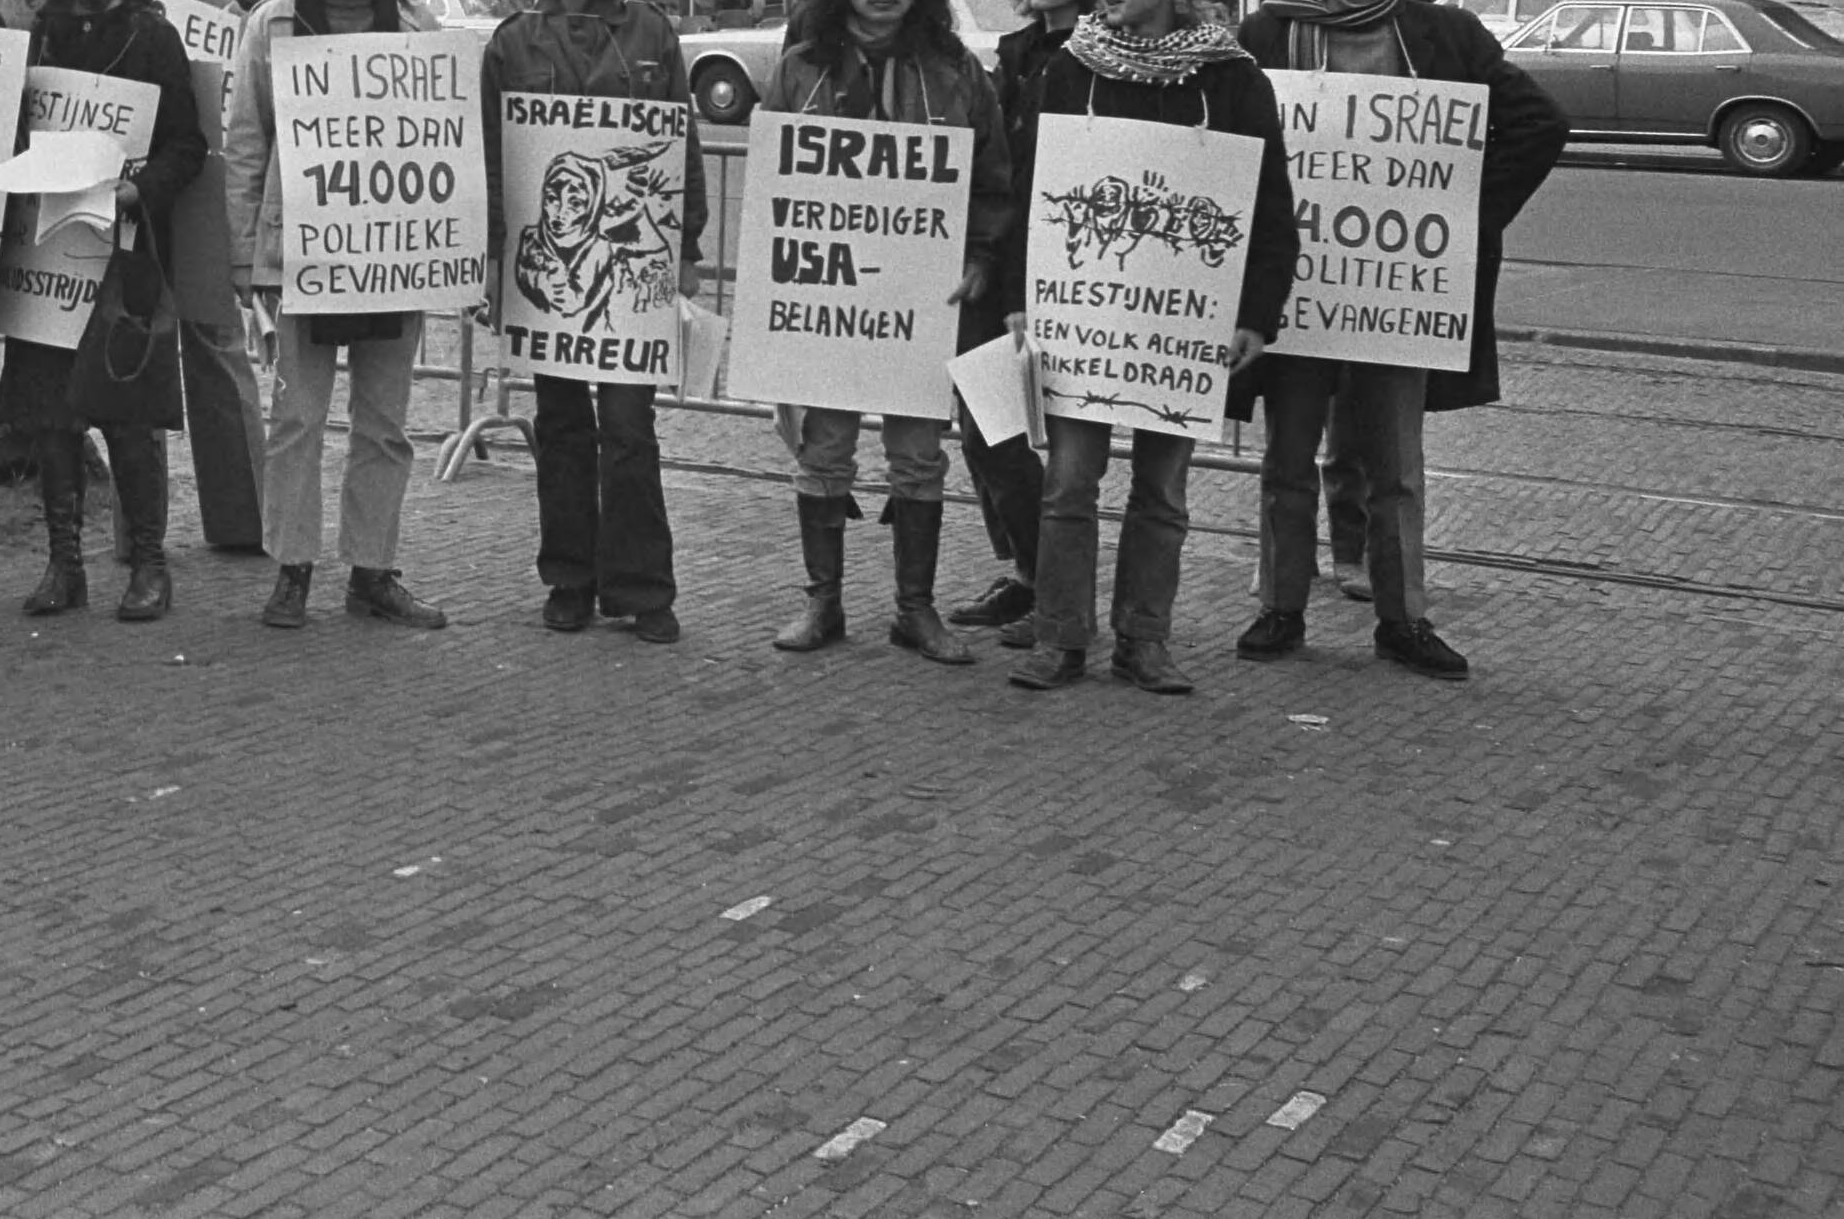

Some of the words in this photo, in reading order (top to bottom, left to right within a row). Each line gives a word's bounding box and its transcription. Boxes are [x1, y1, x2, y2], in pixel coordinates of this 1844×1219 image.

[292, 62, 328, 96] IN
[352, 54, 467, 102] ISRAEL
[293, 116, 385, 148] MEER
[396, 115, 463, 148] DAN
[507, 96, 688, 137] ISRAËLISCHE
[1346, 93, 1484, 151] ISRAEL
[778, 124, 959, 183] ISRAEL
[1386, 157, 1454, 190] DAN
[303, 160, 455, 206] 14.000
[772, 197, 949, 239] VERDEDIGER
[1295, 198, 1450, 259] 4.000
[296, 252, 486, 295] GEVANGENEN
[1294, 253, 1449, 294] OLITIEKE
[769, 300, 914, 341] BELANGEN
[1036, 279, 1218, 319] PALESTIJNEN:
[505, 325, 669, 374] TERREUR
[1035, 318, 1070, 340] EEN
[1075, 324, 1139, 350] VOLK
[1147, 333, 1232, 368] ACHTER
[1041, 351, 1213, 395] RIKKELDRAAD
